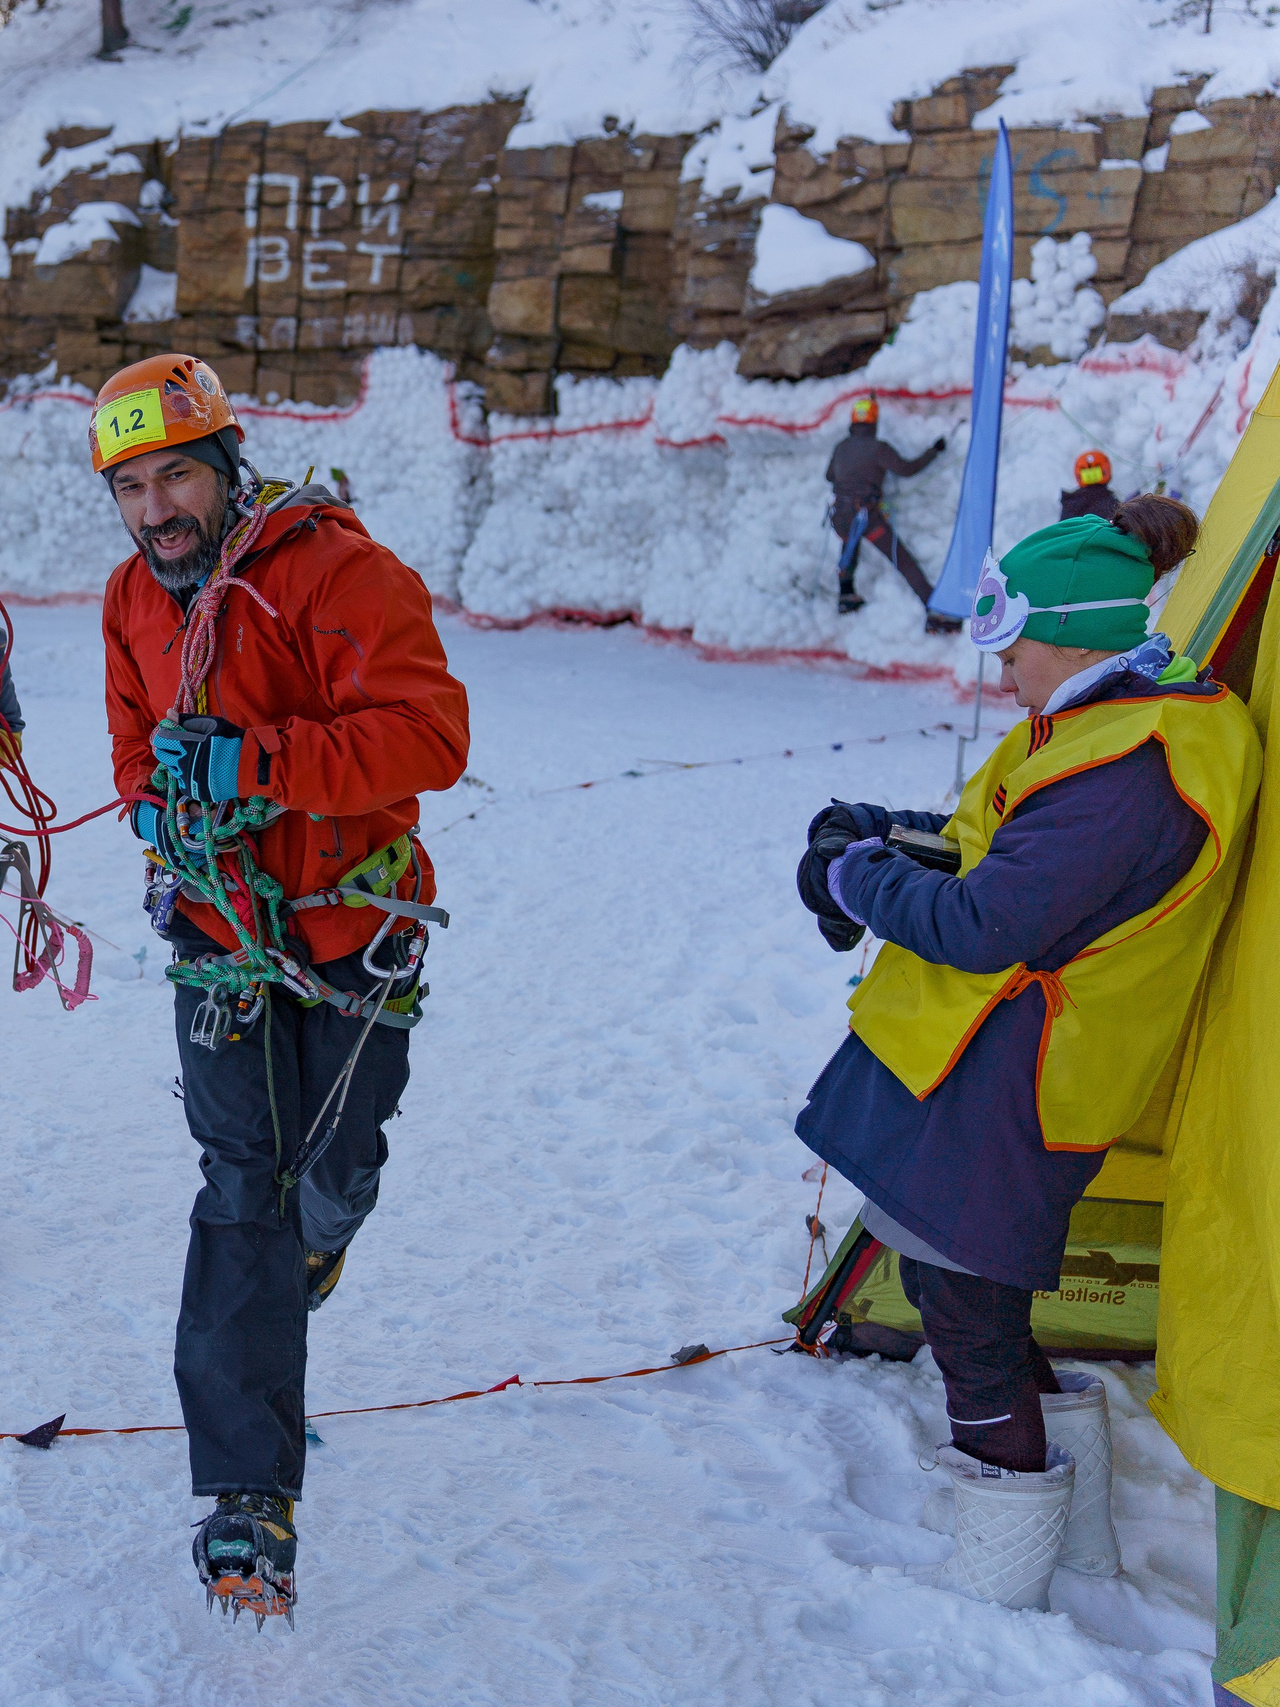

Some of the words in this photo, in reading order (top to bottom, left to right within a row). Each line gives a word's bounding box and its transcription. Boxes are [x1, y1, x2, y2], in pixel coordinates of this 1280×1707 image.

[244, 173, 401, 237] ПРИ
[243, 236, 404, 290] ВЕТ
[109, 408, 146, 438] 1.2
